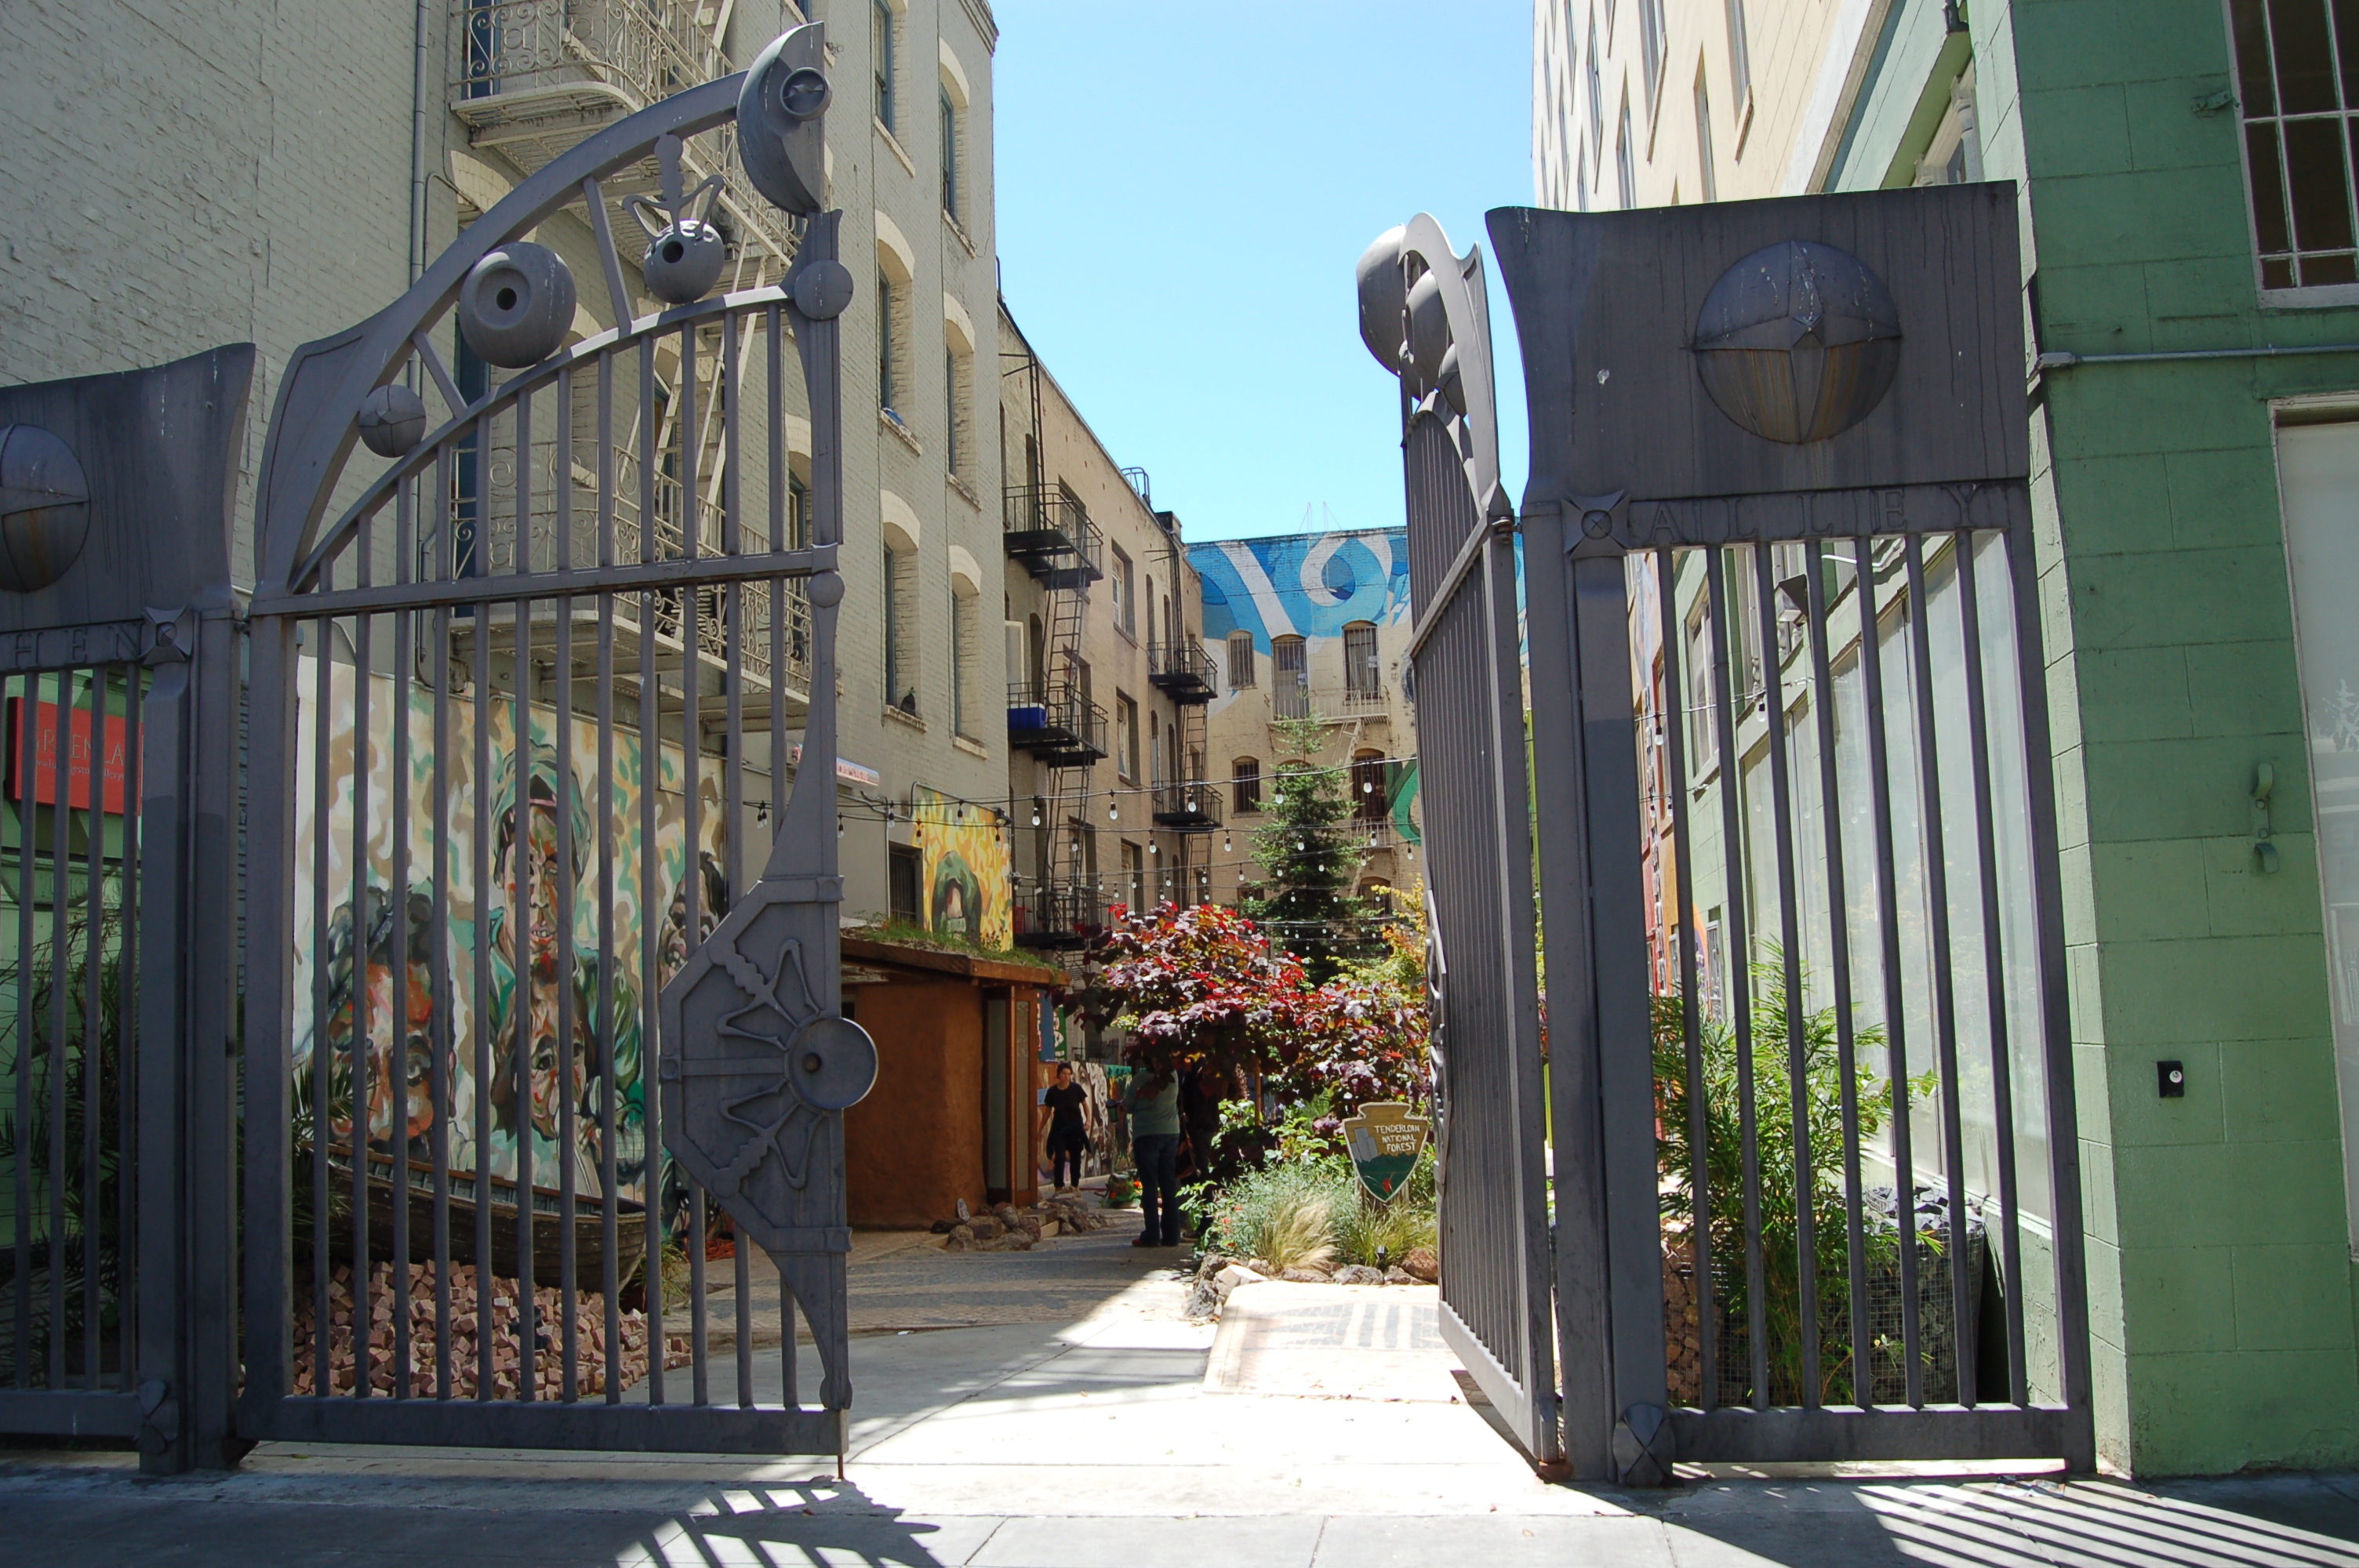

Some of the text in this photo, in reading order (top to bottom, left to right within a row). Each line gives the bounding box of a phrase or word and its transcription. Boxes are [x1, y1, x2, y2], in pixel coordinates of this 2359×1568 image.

[1648, 482, 1984, 546] ALLEY
[1374, 1124, 1420, 1134] TENDERLOIN
[1382, 1134, 1416, 1143] NATIONAL
[1387, 1142, 1416, 1152] FOREST
